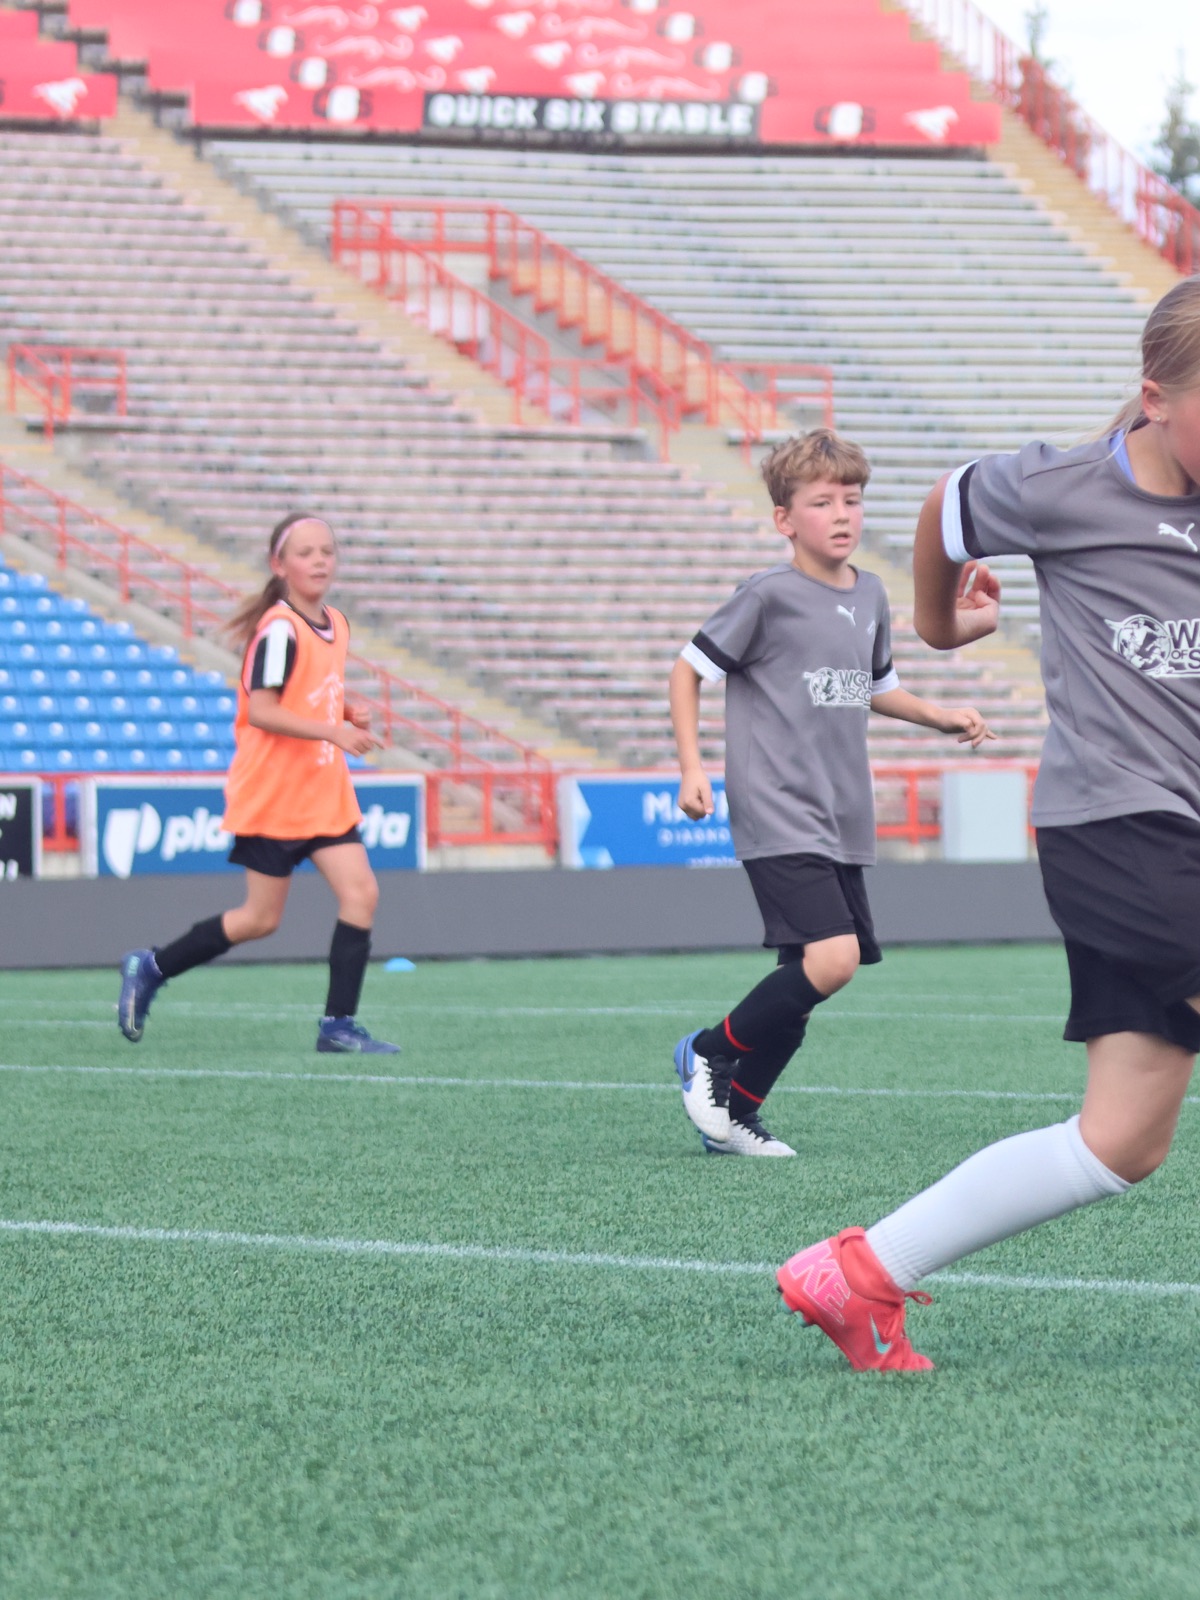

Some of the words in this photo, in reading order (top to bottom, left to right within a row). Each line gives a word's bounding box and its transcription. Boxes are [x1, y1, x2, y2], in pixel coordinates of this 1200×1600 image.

[428, 93, 538, 128] QUICK
[543, 98, 605, 131] SIX
[610, 101, 753, 135] STABLE
[1171, 649, 1190, 660] OF
